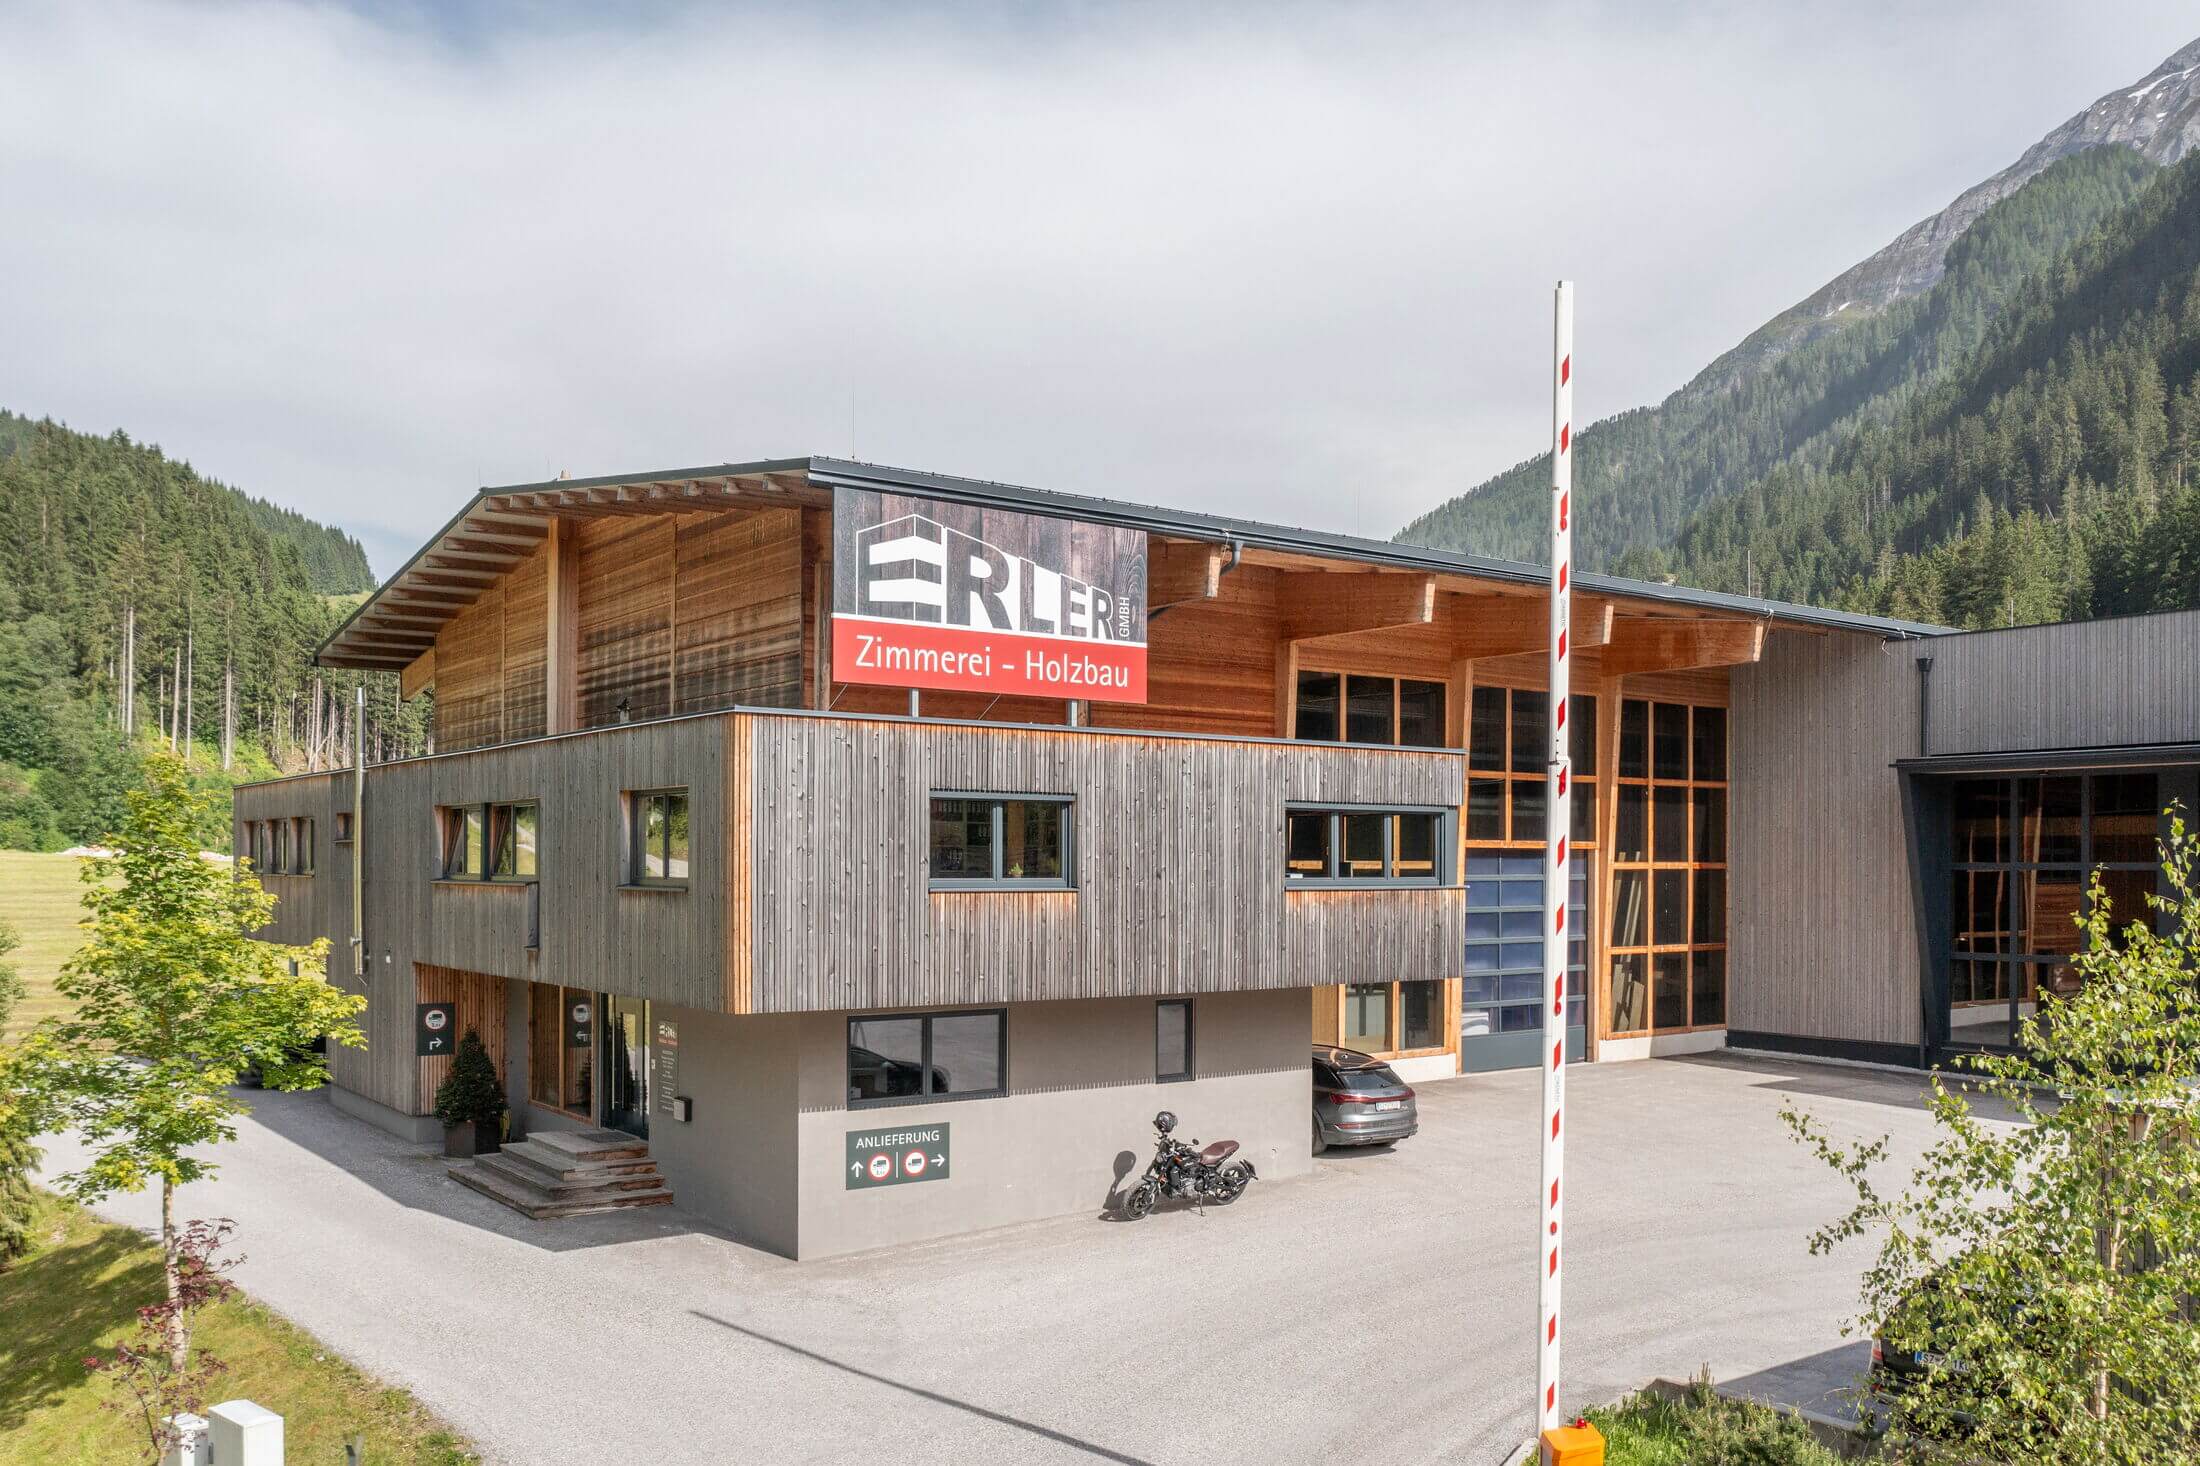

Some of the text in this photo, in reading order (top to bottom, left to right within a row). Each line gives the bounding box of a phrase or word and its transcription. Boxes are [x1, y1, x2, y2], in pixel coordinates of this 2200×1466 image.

[855, 514, 1115, 641] ERLER
[1118, 596, 1130, 638] GMBH
[855, 634, 991, 677] Zimmerei
[1026, 650, 1129, 688] Holzbau
[856, 1130, 940, 1149] ANLIEFERUNG
